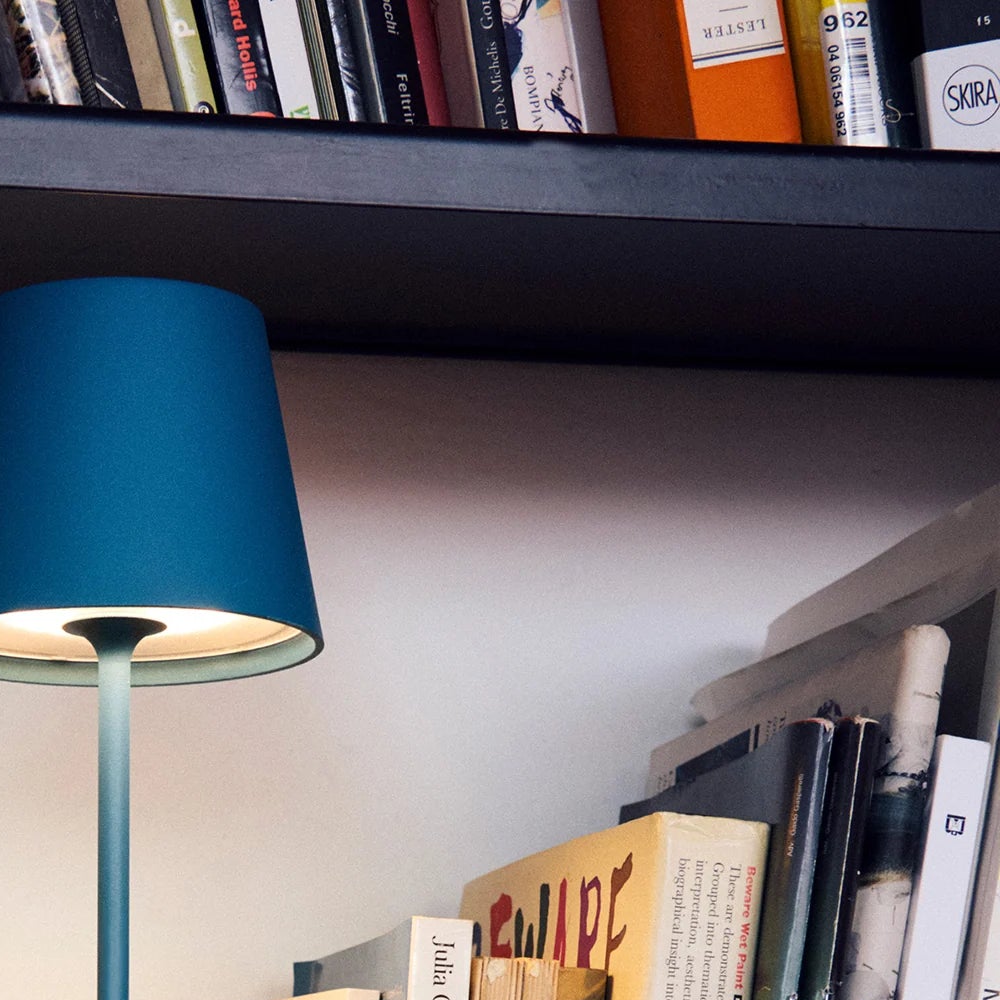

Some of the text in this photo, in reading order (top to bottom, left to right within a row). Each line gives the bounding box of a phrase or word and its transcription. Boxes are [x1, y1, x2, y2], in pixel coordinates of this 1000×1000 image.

[703, 18, 766, 39] LESTER
[235, 35, 259, 92] Hollis
[486, 41, 509, 116] De Michelis
[827, 45, 847, 137] 04 06154 962
[947, 78, 999, 112] SKIRA
[706, 862, 725, 920] Grouped
[727, 863, 742, 901] These
[741, 865, 757, 919] Beware
[665, 858, 691, 980] biographical insight
[738, 919, 752, 947] Wet
[431, 935, 456, 987] Julia
[733, 953, 747, 990] Paint
